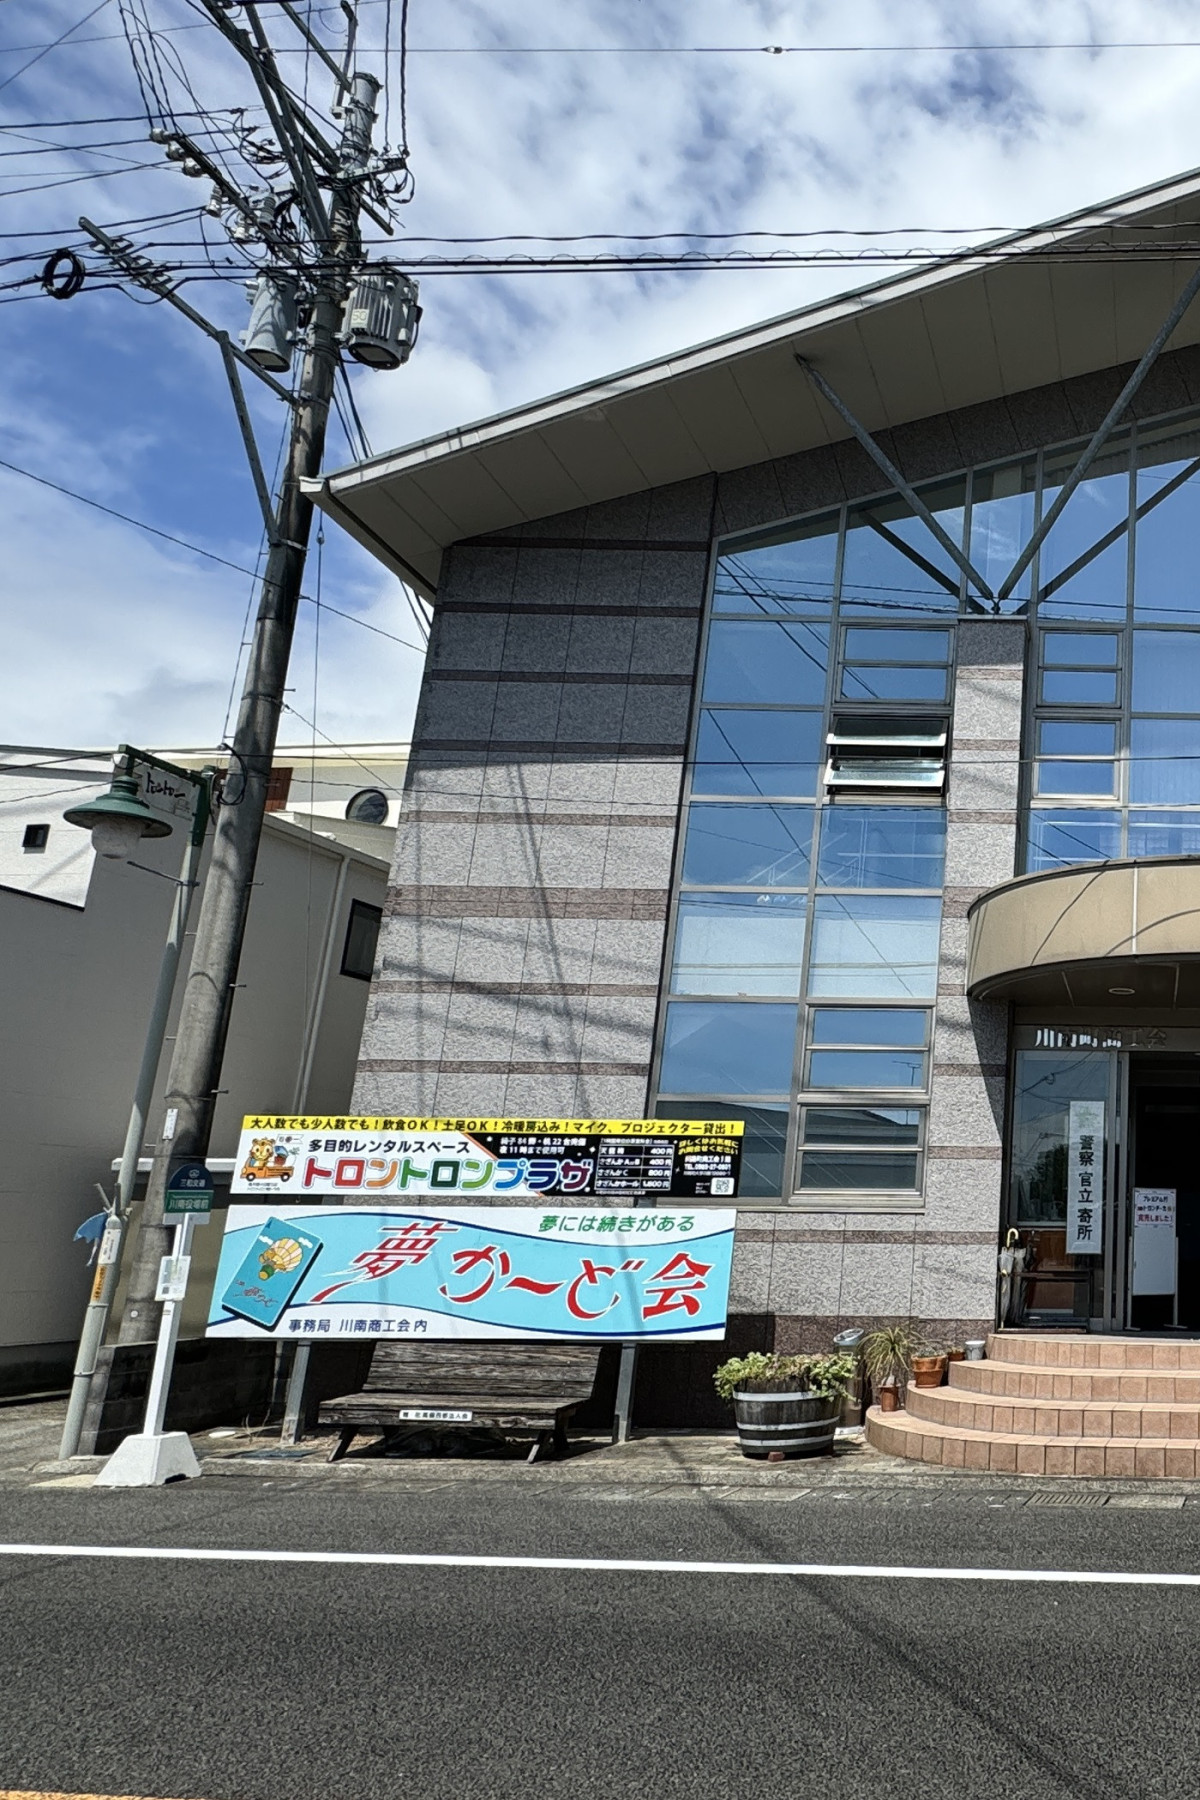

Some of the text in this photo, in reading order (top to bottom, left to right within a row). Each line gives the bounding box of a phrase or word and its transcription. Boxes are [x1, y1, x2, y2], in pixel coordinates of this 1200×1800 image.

[309, 1139, 471, 1154] 多目的レンタルスペース
[303, 1157, 594, 1191] トロントロンプラザ
[538, 1215, 696, 1233] 夢には続きがある
[289, 1319, 428, 1333] 事務局 川南商工会内
